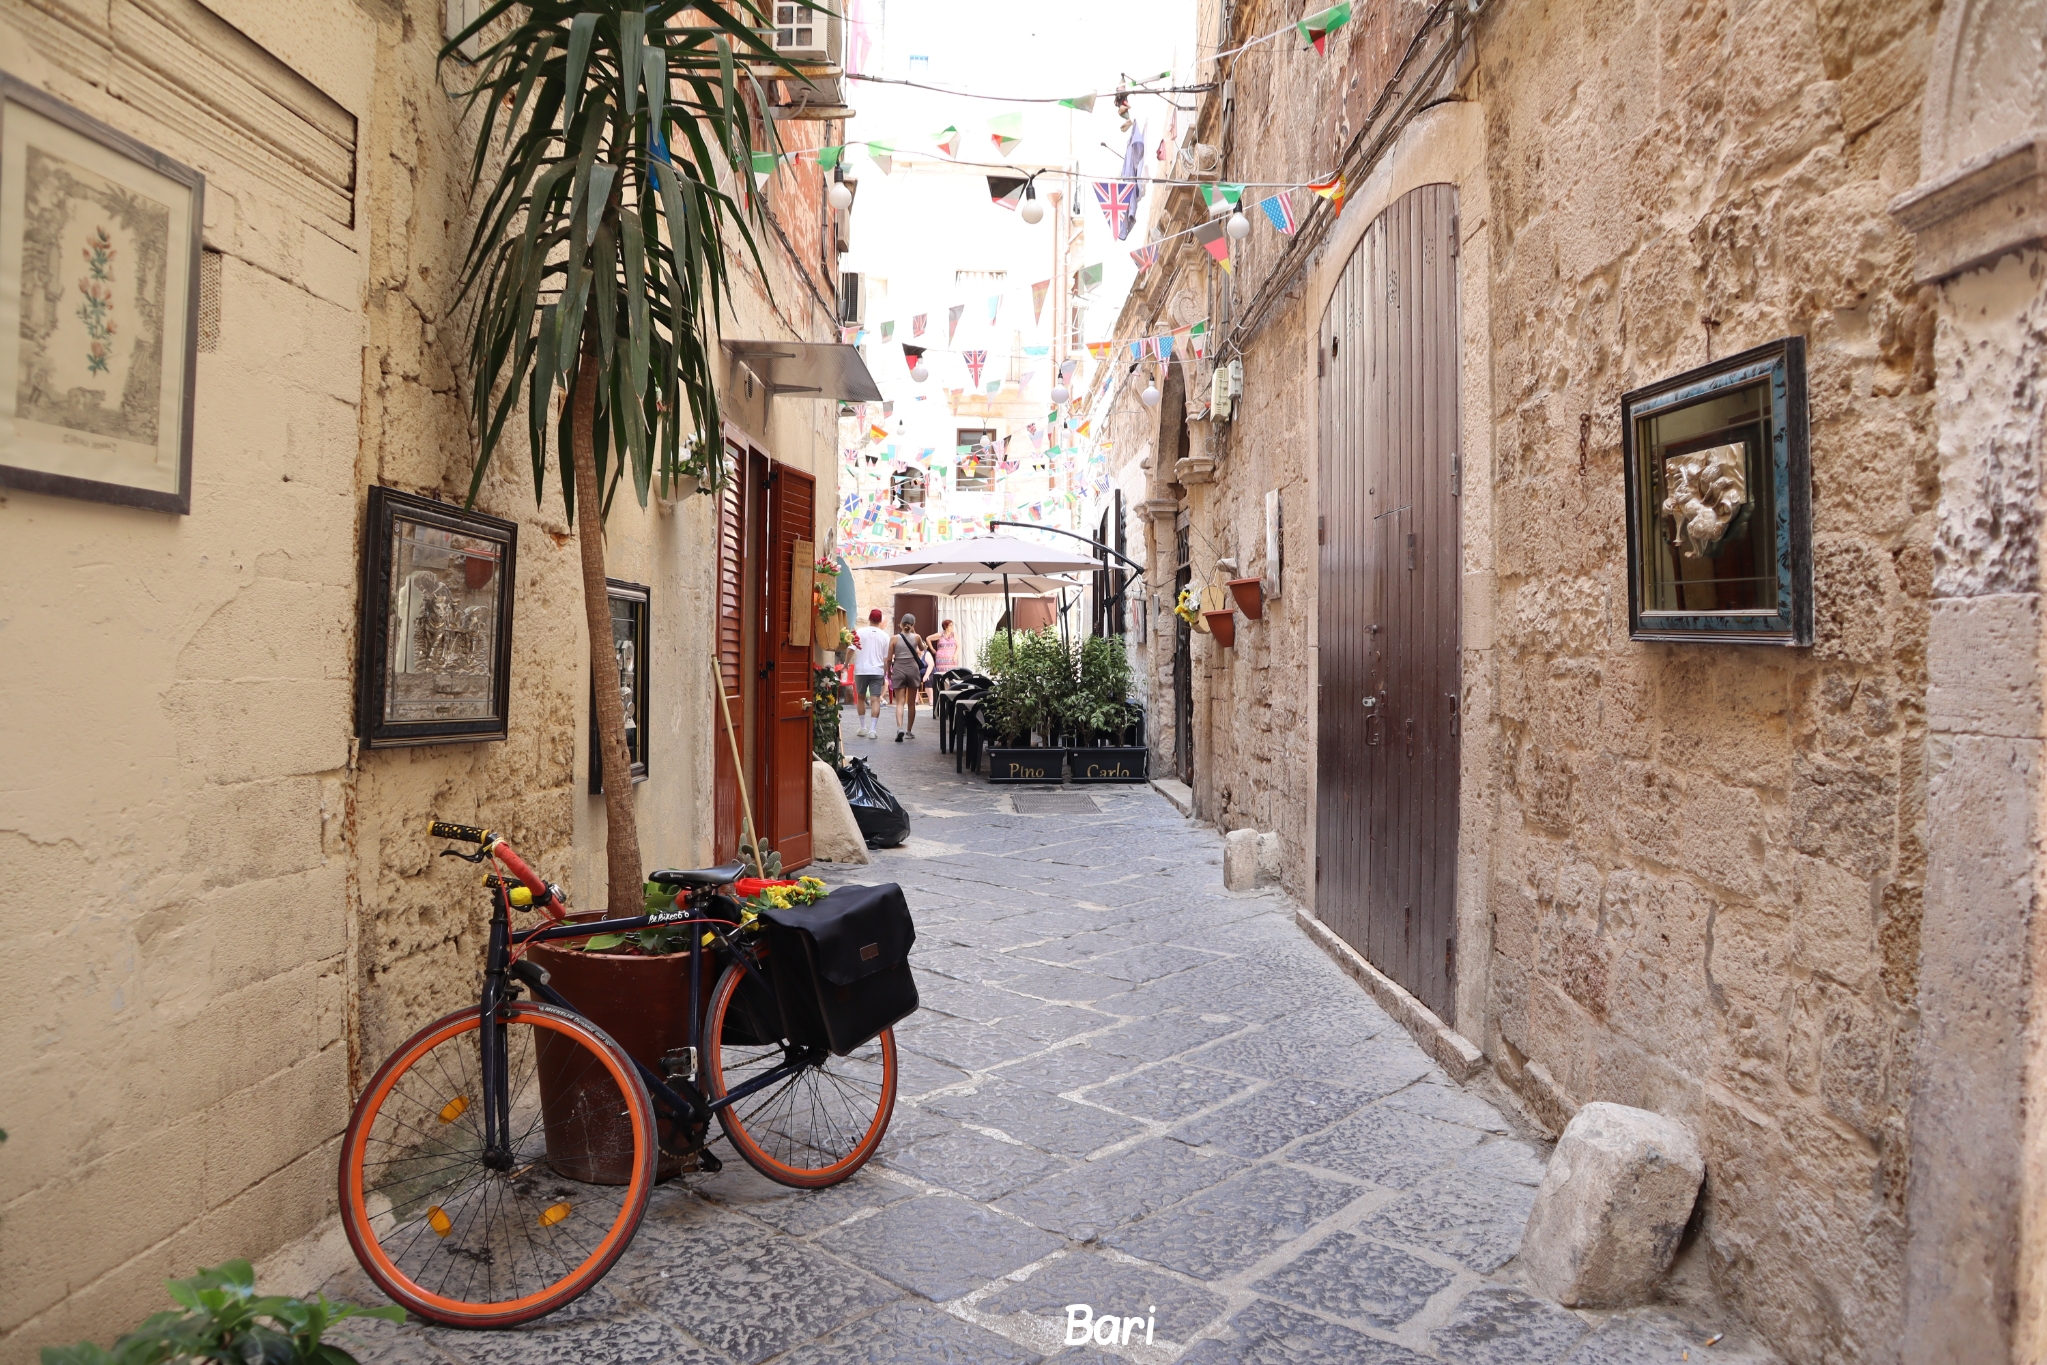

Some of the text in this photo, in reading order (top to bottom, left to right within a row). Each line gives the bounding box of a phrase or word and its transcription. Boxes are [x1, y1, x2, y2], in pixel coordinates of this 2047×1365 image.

[1008, 763, 1045, 778] Pino
[1087, 762, 1130, 778] Carlo
[545, 1007, 575, 1020] MICHELIN
[574, 1017, 594, 1033] Dynamic
